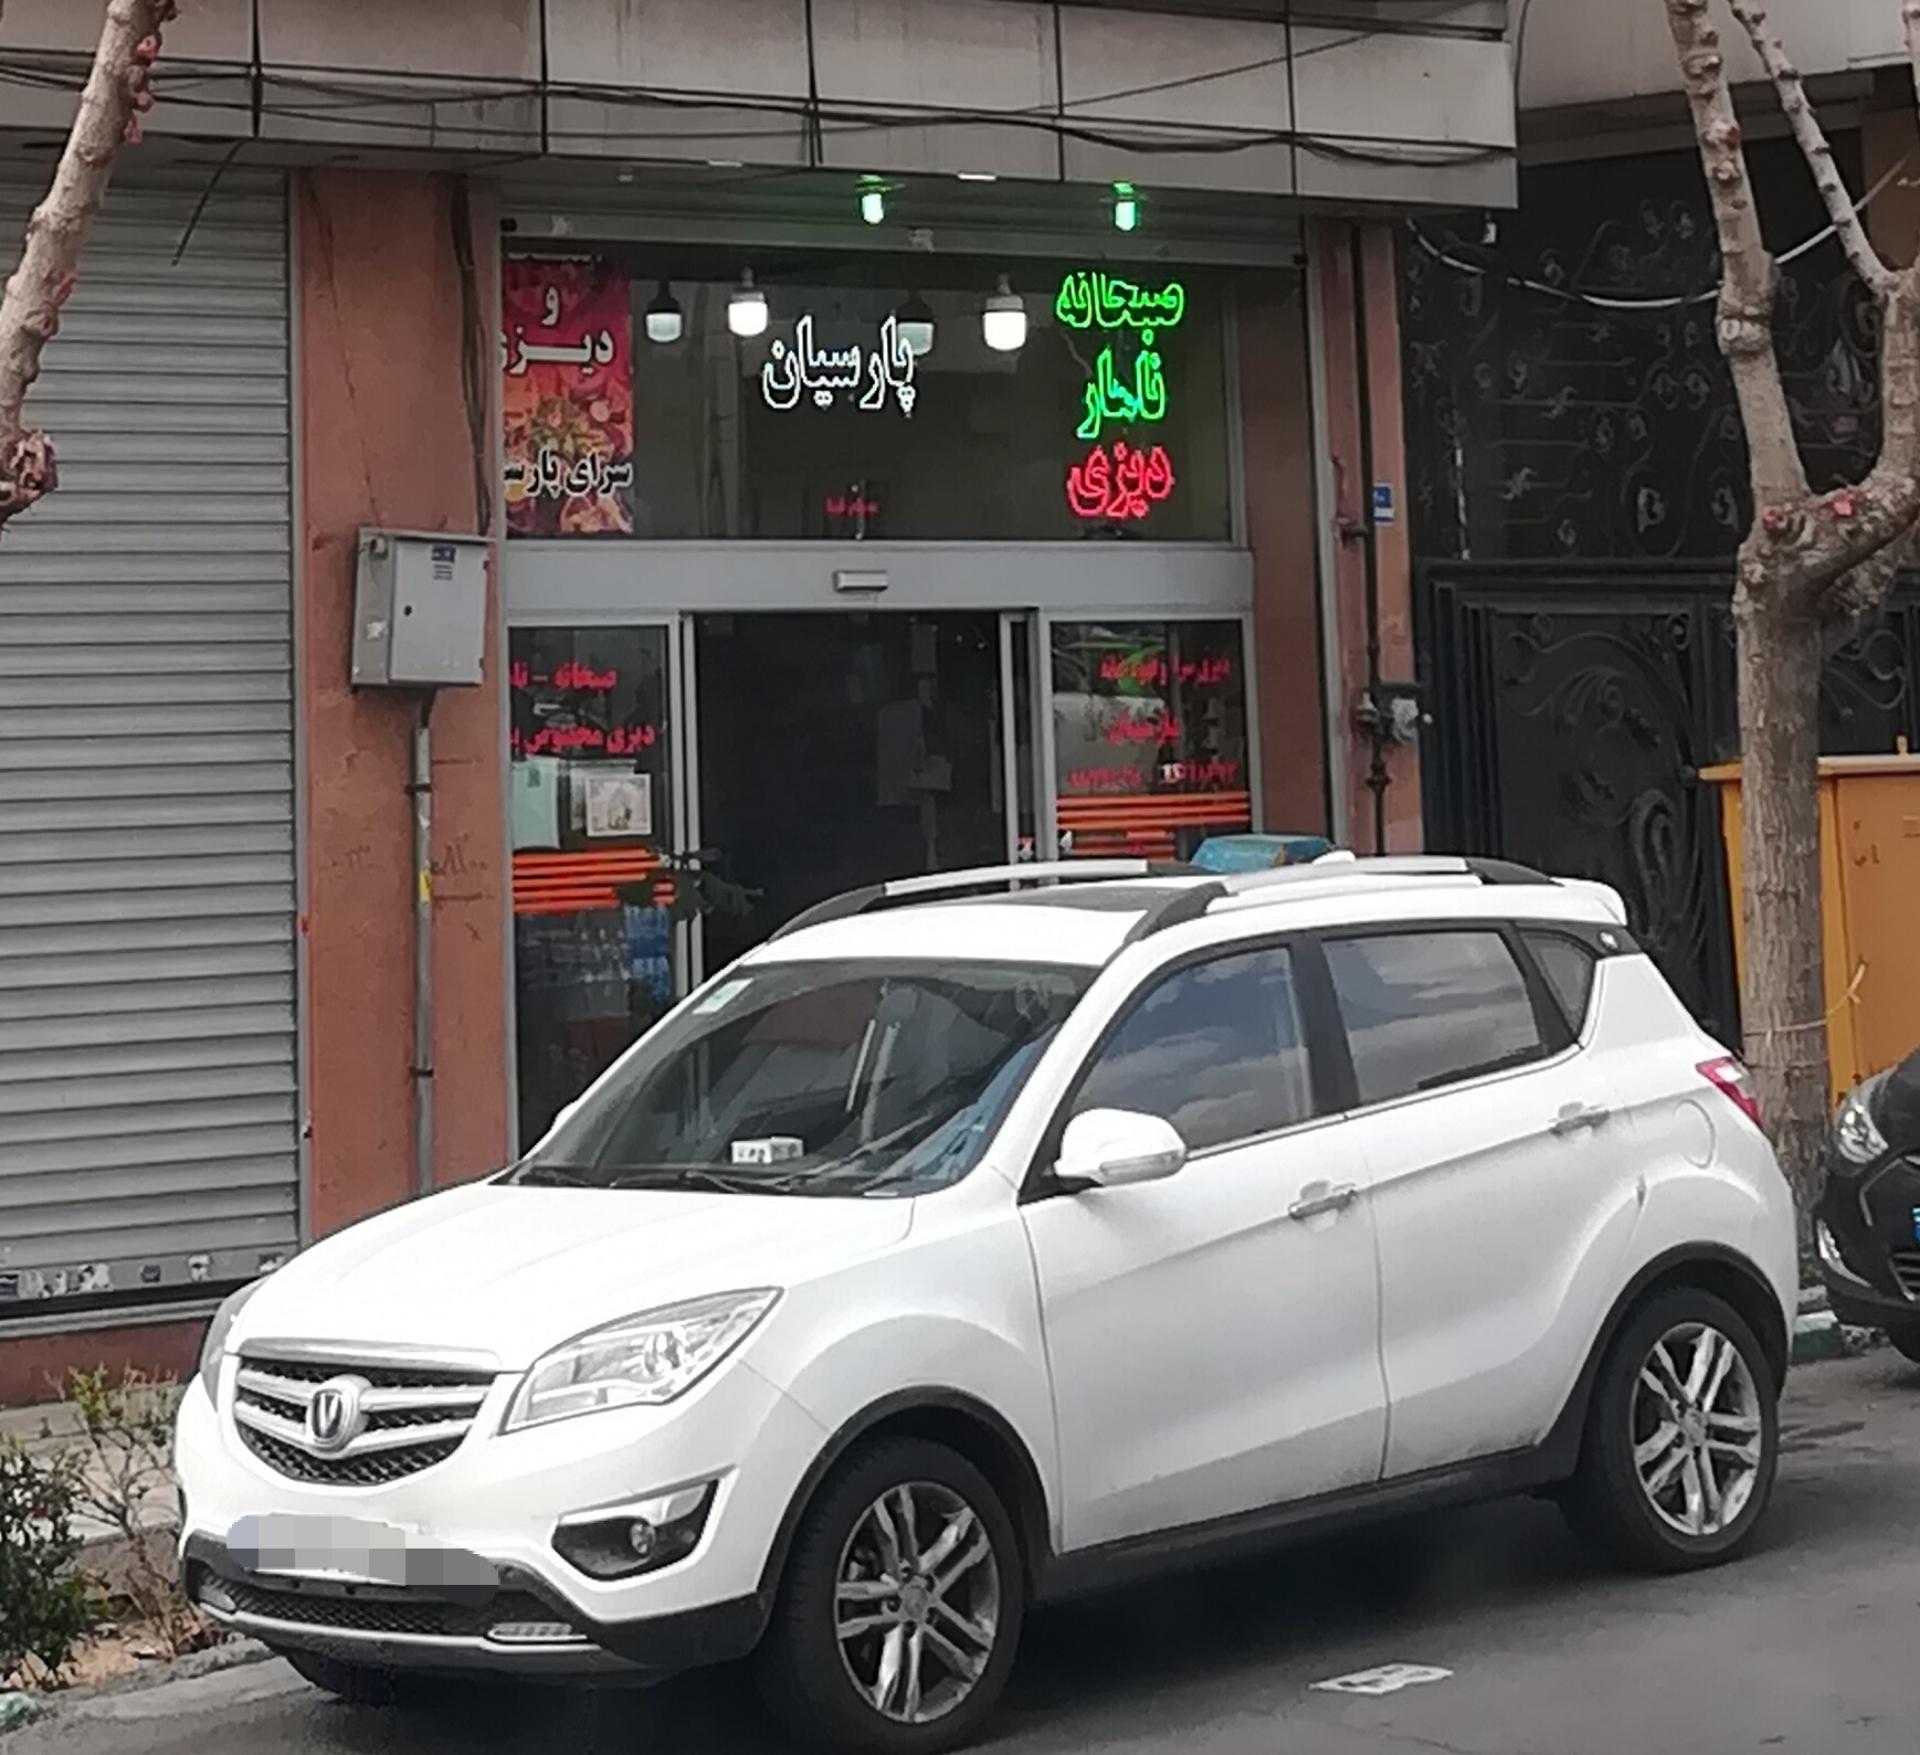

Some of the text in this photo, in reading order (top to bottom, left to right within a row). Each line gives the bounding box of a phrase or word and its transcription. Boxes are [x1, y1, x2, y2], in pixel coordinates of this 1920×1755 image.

[542, 286, 559, 326] و
[1056, 272, 1184, 345] صبحانه
[763, 315, 915, 411] پارسیان
[1076, 347, 1166, 438] ناهار
[565, 450, 633, 497] سرای
[1067, 442, 1175, 518] دیزی
